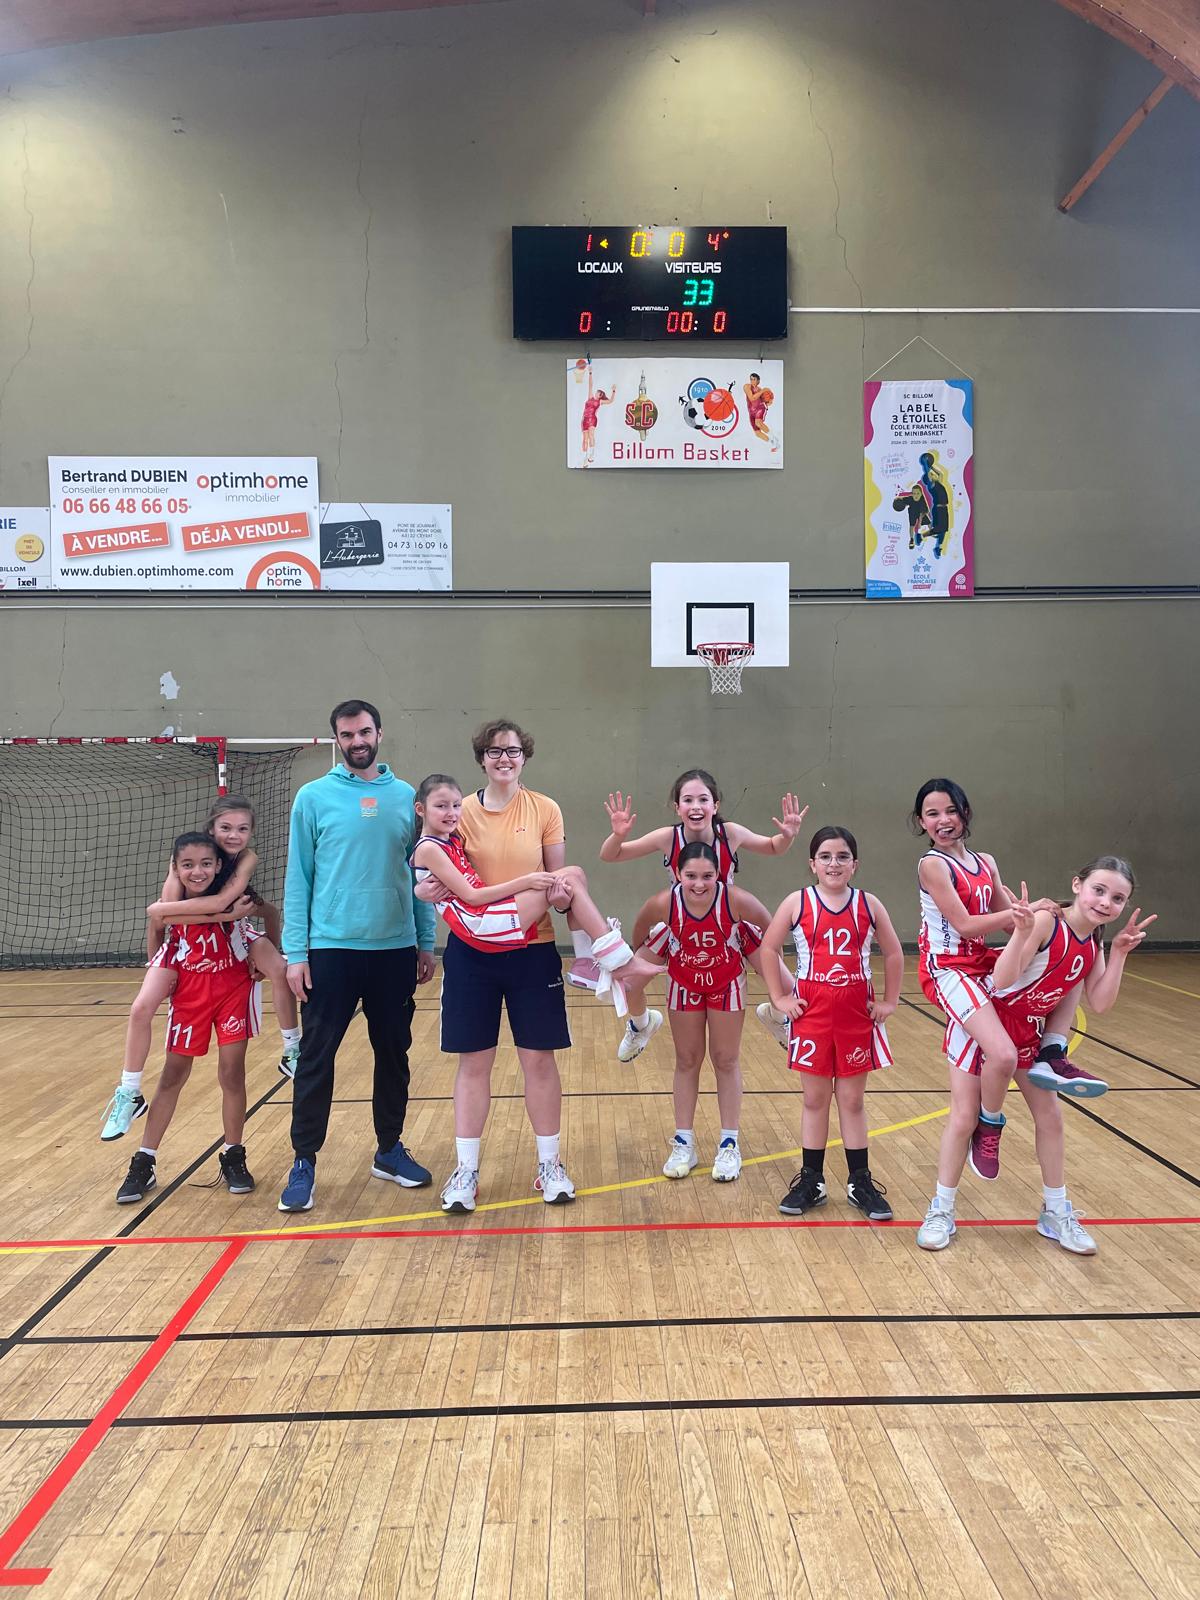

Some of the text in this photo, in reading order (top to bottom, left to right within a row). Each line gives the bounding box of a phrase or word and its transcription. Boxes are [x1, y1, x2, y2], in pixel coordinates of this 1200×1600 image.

[577, 262, 623, 273] LOCAUX
[665, 262, 721, 273] VISITEURS
[682, 279, 714, 306] 33
[899, 403, 938, 413] LABEL
[892, 413, 946, 423] 3 ÉTOILES
[612, 442, 749, 461] Billom Basket
[61, 469, 188, 483] Bertrand DUBIEN
[196, 471, 308, 492] optimhome
[62, 485, 106, 494] Conseiller
[122, 485, 168, 494] immobilier
[225, 492, 280, 503] immobilier
[63, 498, 188, 513] 06 66 48 66 05
[190, 525, 232, 545] DÉJÀ
[71, 535, 83, 552] À
[388, 541, 448, 549] 04 73 16 09 16
[323, 548, 380, 565] L'Aubergerie
[60, 565, 234, 578] www.dubien.optimhome.com
[266, 567, 302, 578] optim
[18, 578, 37, 586] ixell
[267, 576, 302, 587] home
[975, 884, 992, 914] 10
[195, 932, 218, 956] 11
[688, 931, 717, 948] 15
[823, 927, 852, 956] 12
[1065, 954, 1084, 982] 9
[172, 1023, 192, 1049] 11
[790, 1035, 817, 1067] 12
